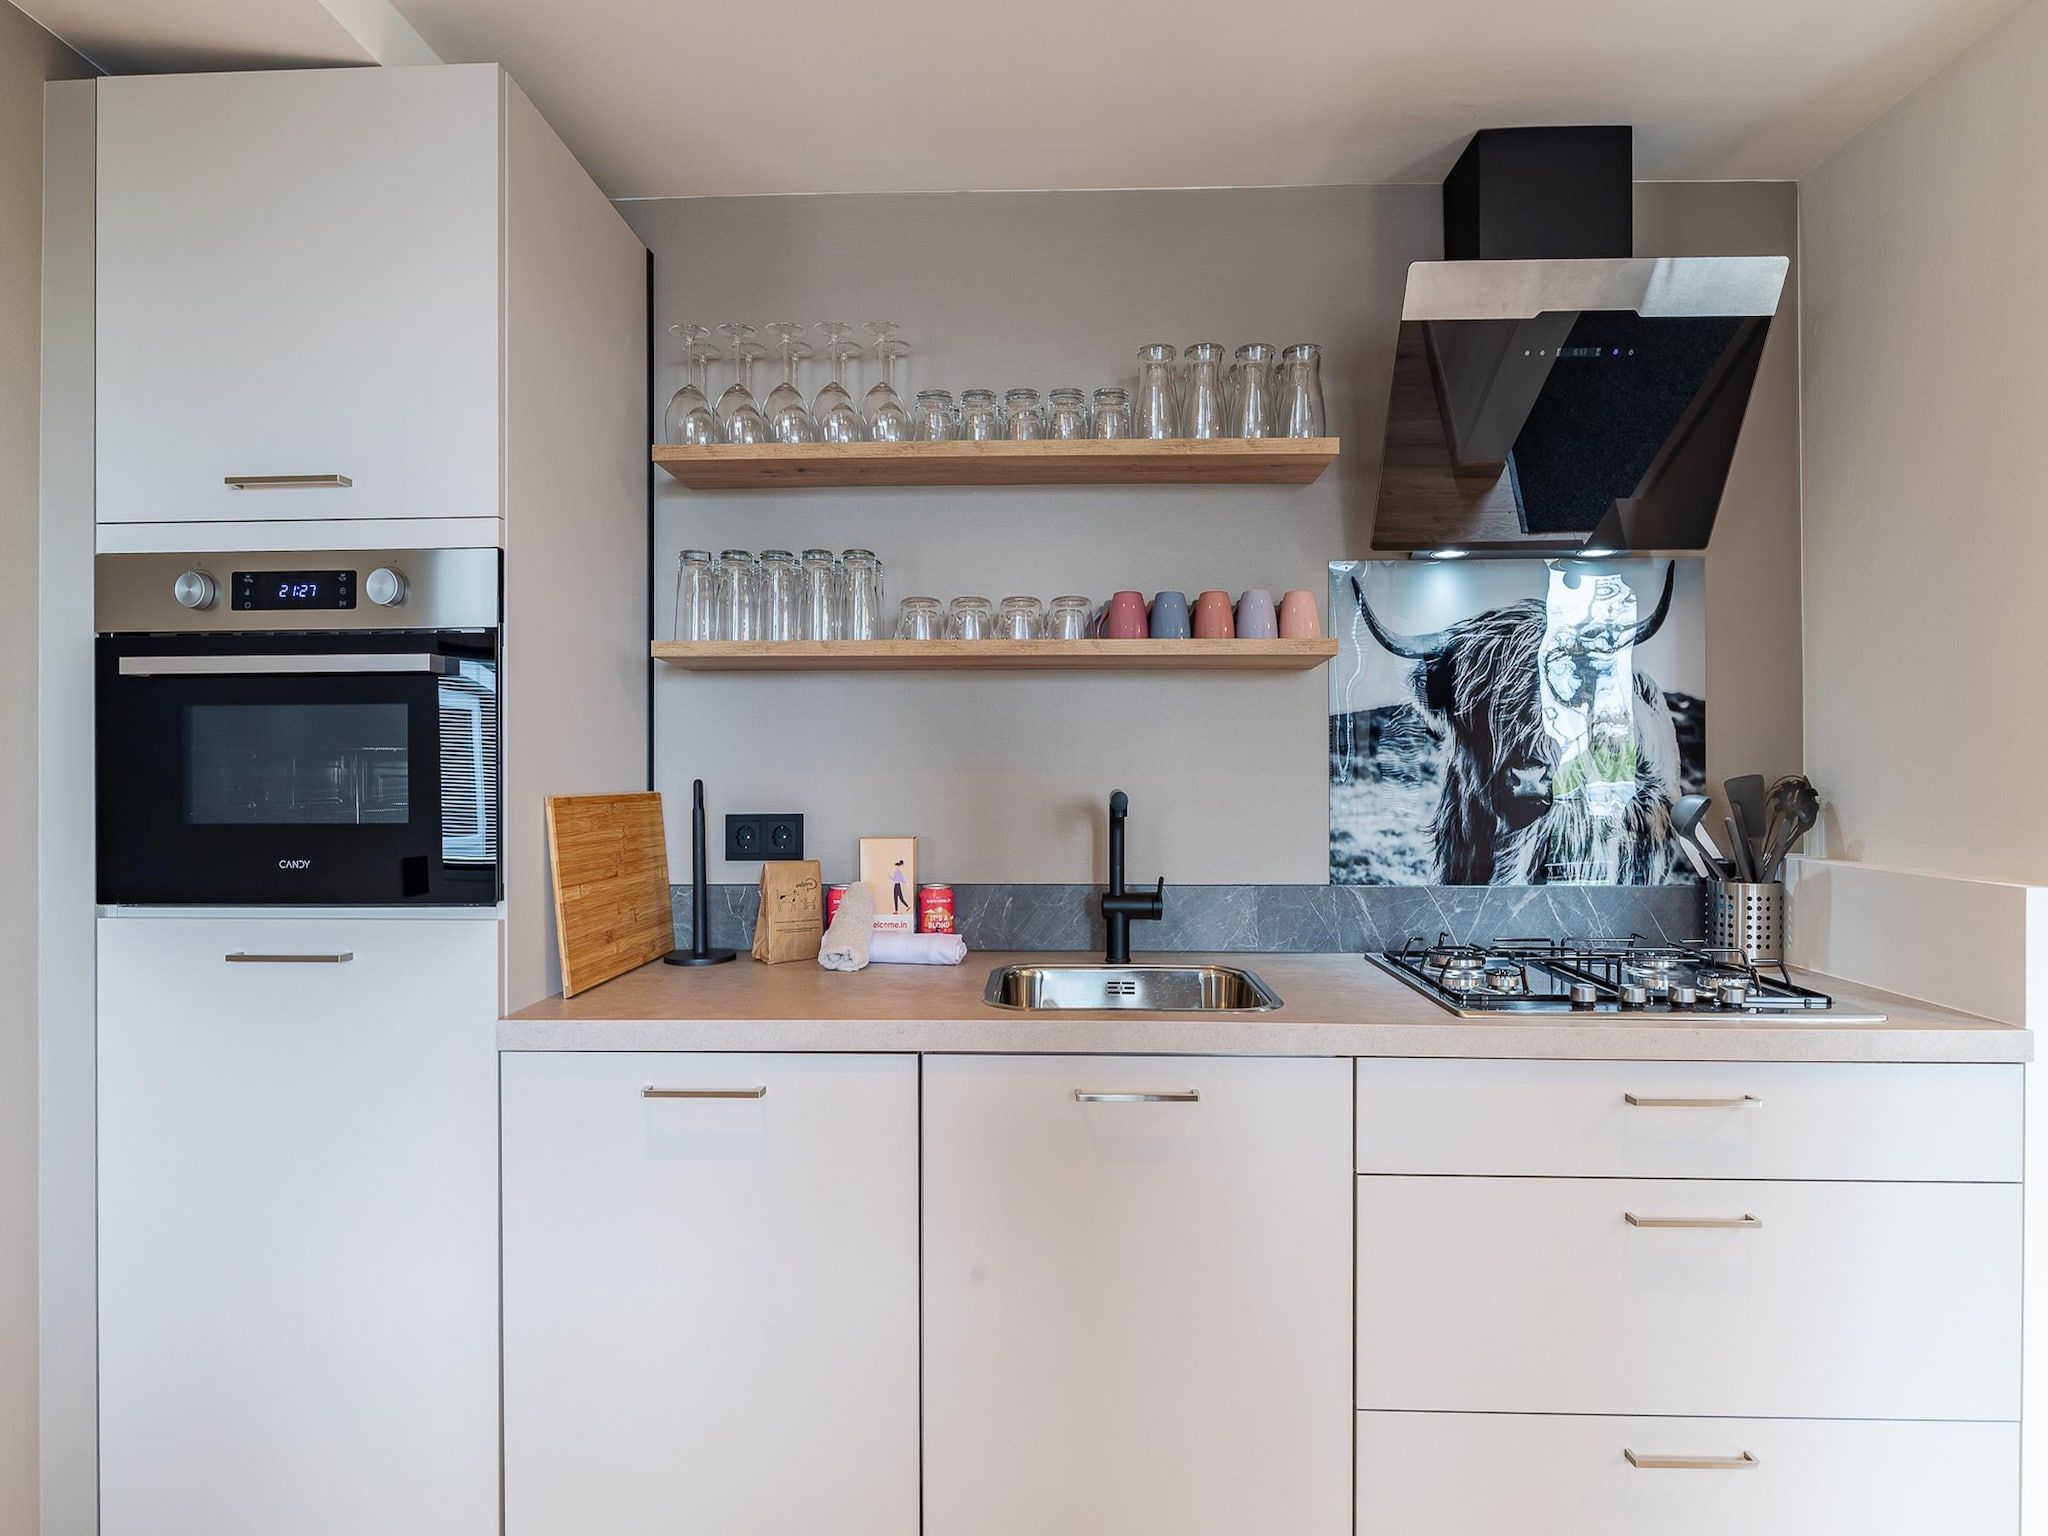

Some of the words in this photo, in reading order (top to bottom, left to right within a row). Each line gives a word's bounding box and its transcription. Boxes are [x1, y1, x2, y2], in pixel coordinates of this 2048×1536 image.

[278, 584, 317, 598] 21:27
[279, 859, 311, 869] CANDY
[872, 920, 908, 929] elcome.in
[928, 921, 950, 929] BLOND
